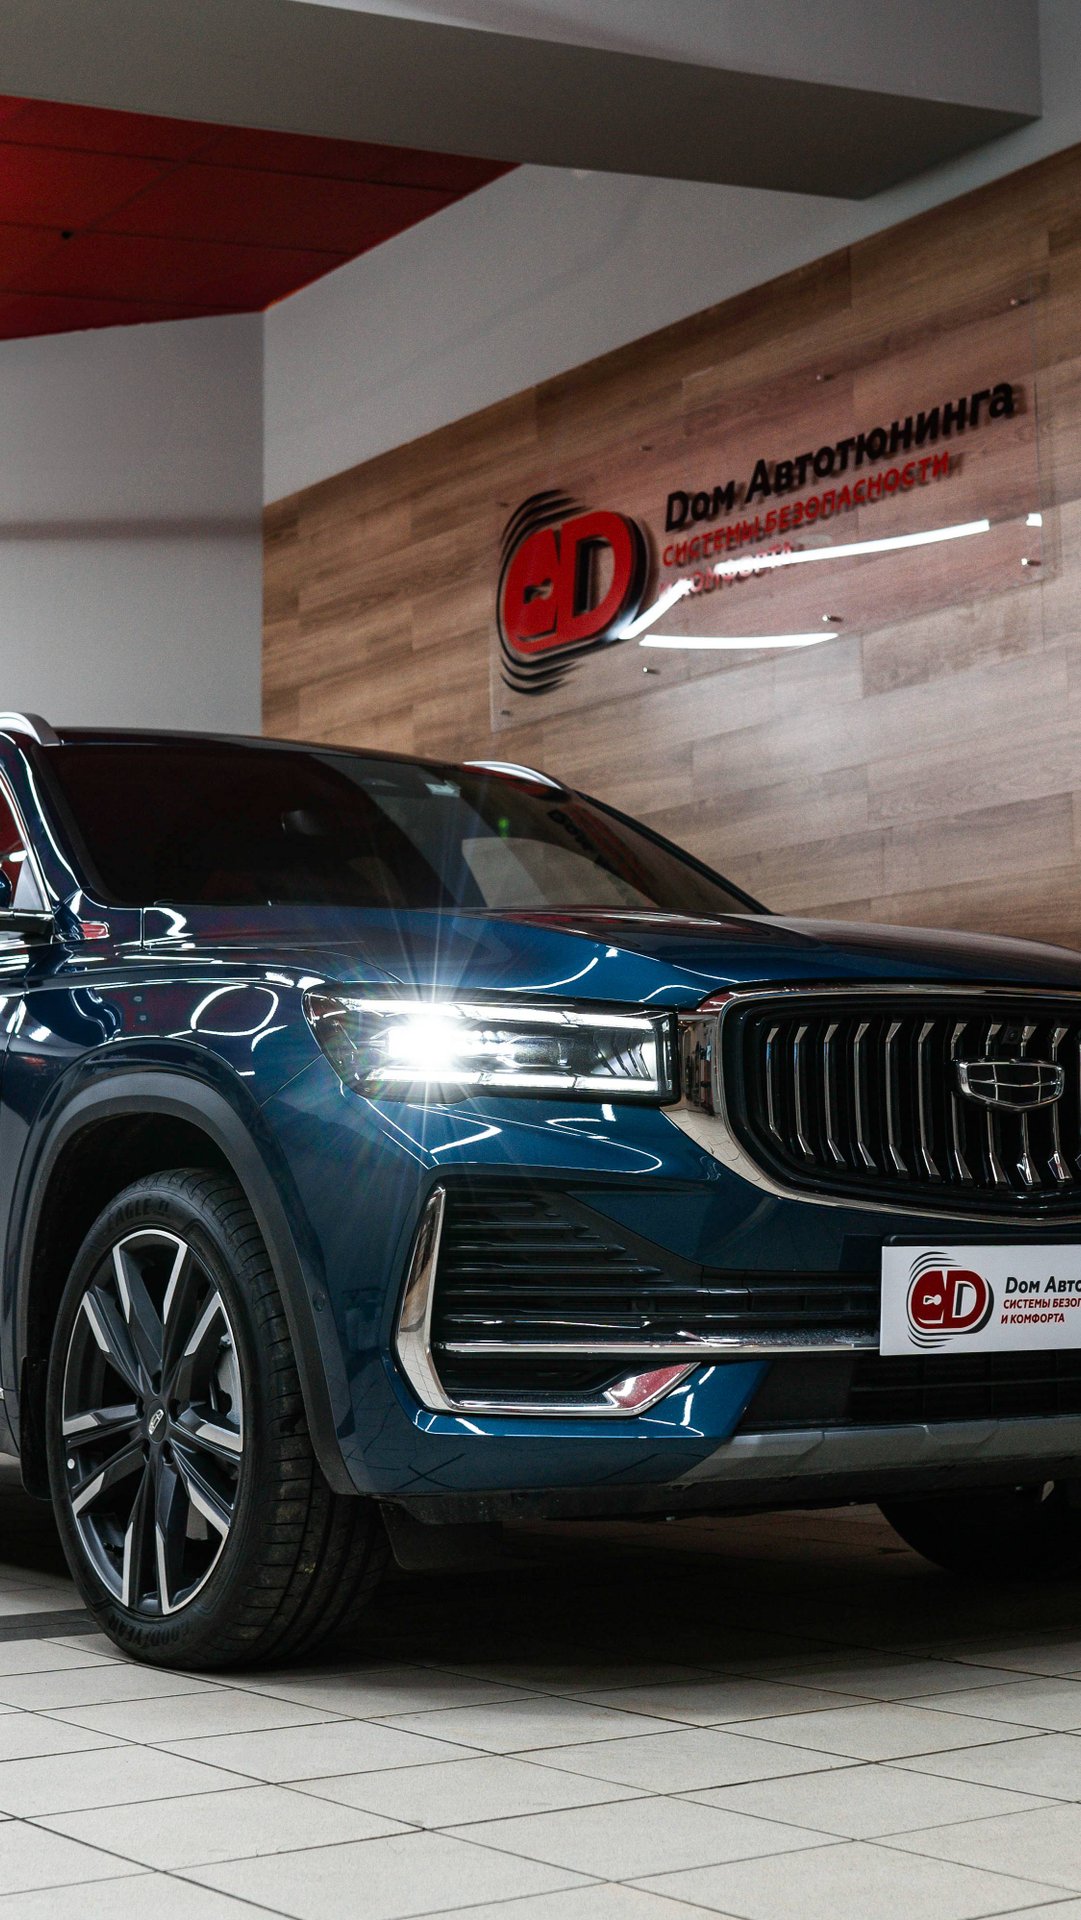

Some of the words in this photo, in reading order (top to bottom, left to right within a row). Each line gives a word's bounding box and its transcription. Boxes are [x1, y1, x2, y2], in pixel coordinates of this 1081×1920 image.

[745, 382, 1015, 504] Автотюнинга
[663, 515, 760, 567] СИСТЕМЫ
[764, 451, 949, 534] БЕЗОПАСНОСТИ
[1001, 1315, 1009, 1324] И
[1010, 1313, 1065, 1324] КОМФОРТА
[1003, 1299, 1051, 1309] СИСТЕМЫ
